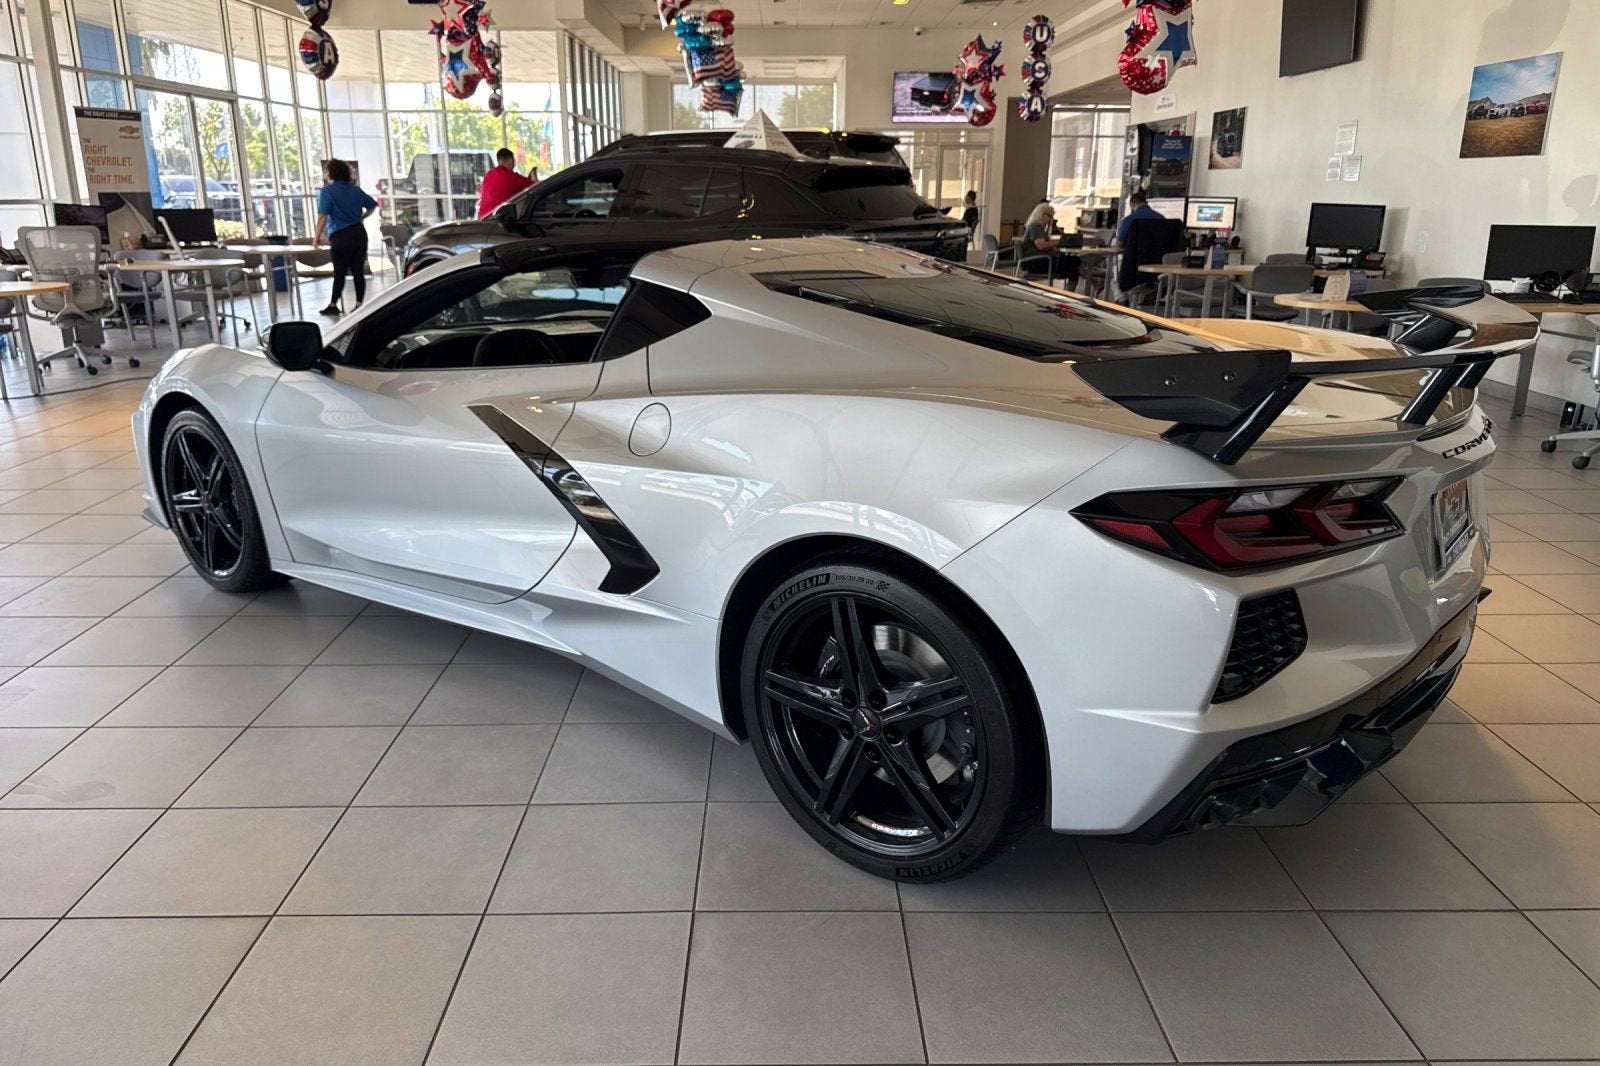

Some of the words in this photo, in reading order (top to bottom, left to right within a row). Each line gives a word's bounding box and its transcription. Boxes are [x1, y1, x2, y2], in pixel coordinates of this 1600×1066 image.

[85, 145, 108, 155] RIGHT
[86, 156, 133, 167] CHEVROLET.
[89, 174, 112, 185] RIGHT
[113, 175, 135, 185] TIME.
[773, 574, 827, 610] MICHELIN
[898, 854, 962, 877] MICHELIN
